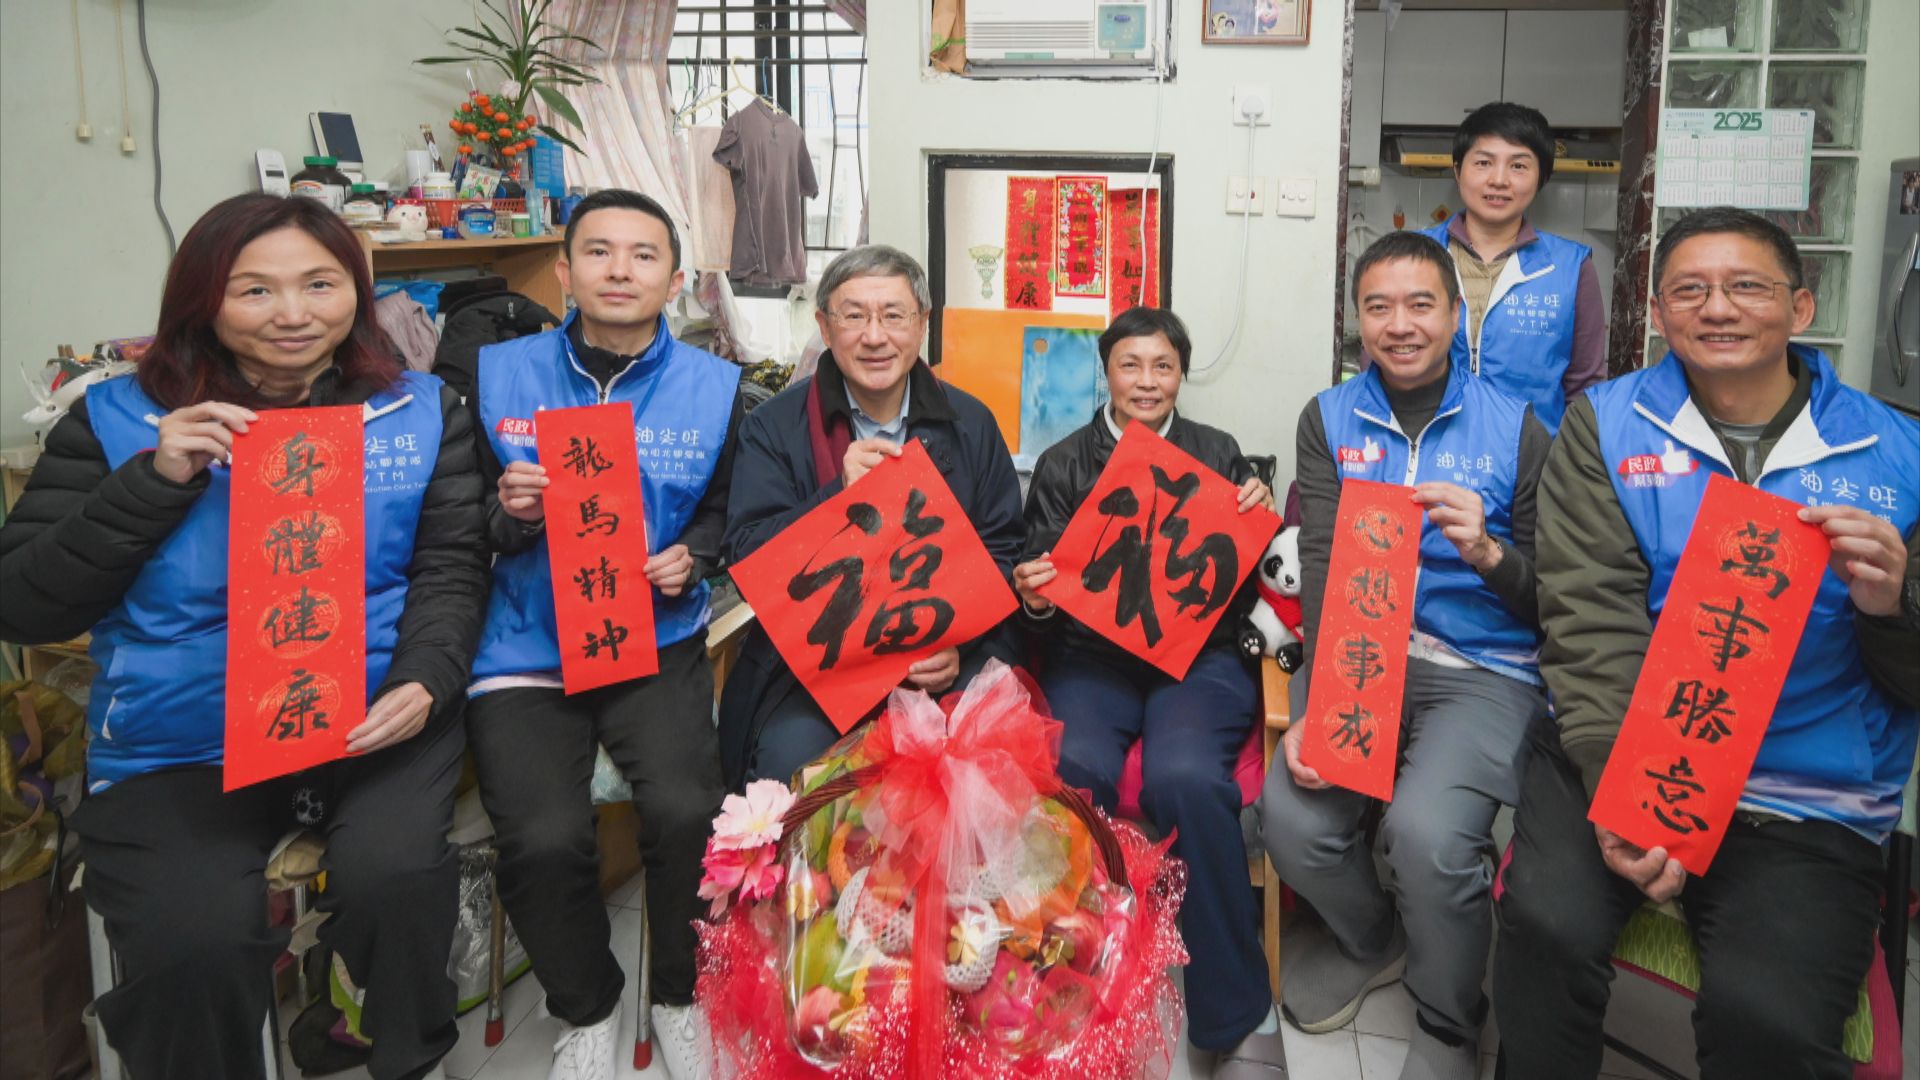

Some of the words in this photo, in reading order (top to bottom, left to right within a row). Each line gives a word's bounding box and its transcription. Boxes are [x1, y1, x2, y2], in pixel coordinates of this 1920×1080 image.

[1713, 112, 1763, 131] 2025
[635, 426, 700, 446] 油尖旺
[1627, 455, 1657, 474] 民政
[1800, 467, 1898, 511] 油尖旺
[263, 431, 331, 741] 身體健康
[562, 436, 629, 662] 龍馬精神
[787, 487, 956, 672] 福
[1081, 463, 1240, 649] 福
[1328, 513, 1404, 760] 心想事成
[1642, 521, 1790, 835] 萬事勝意
